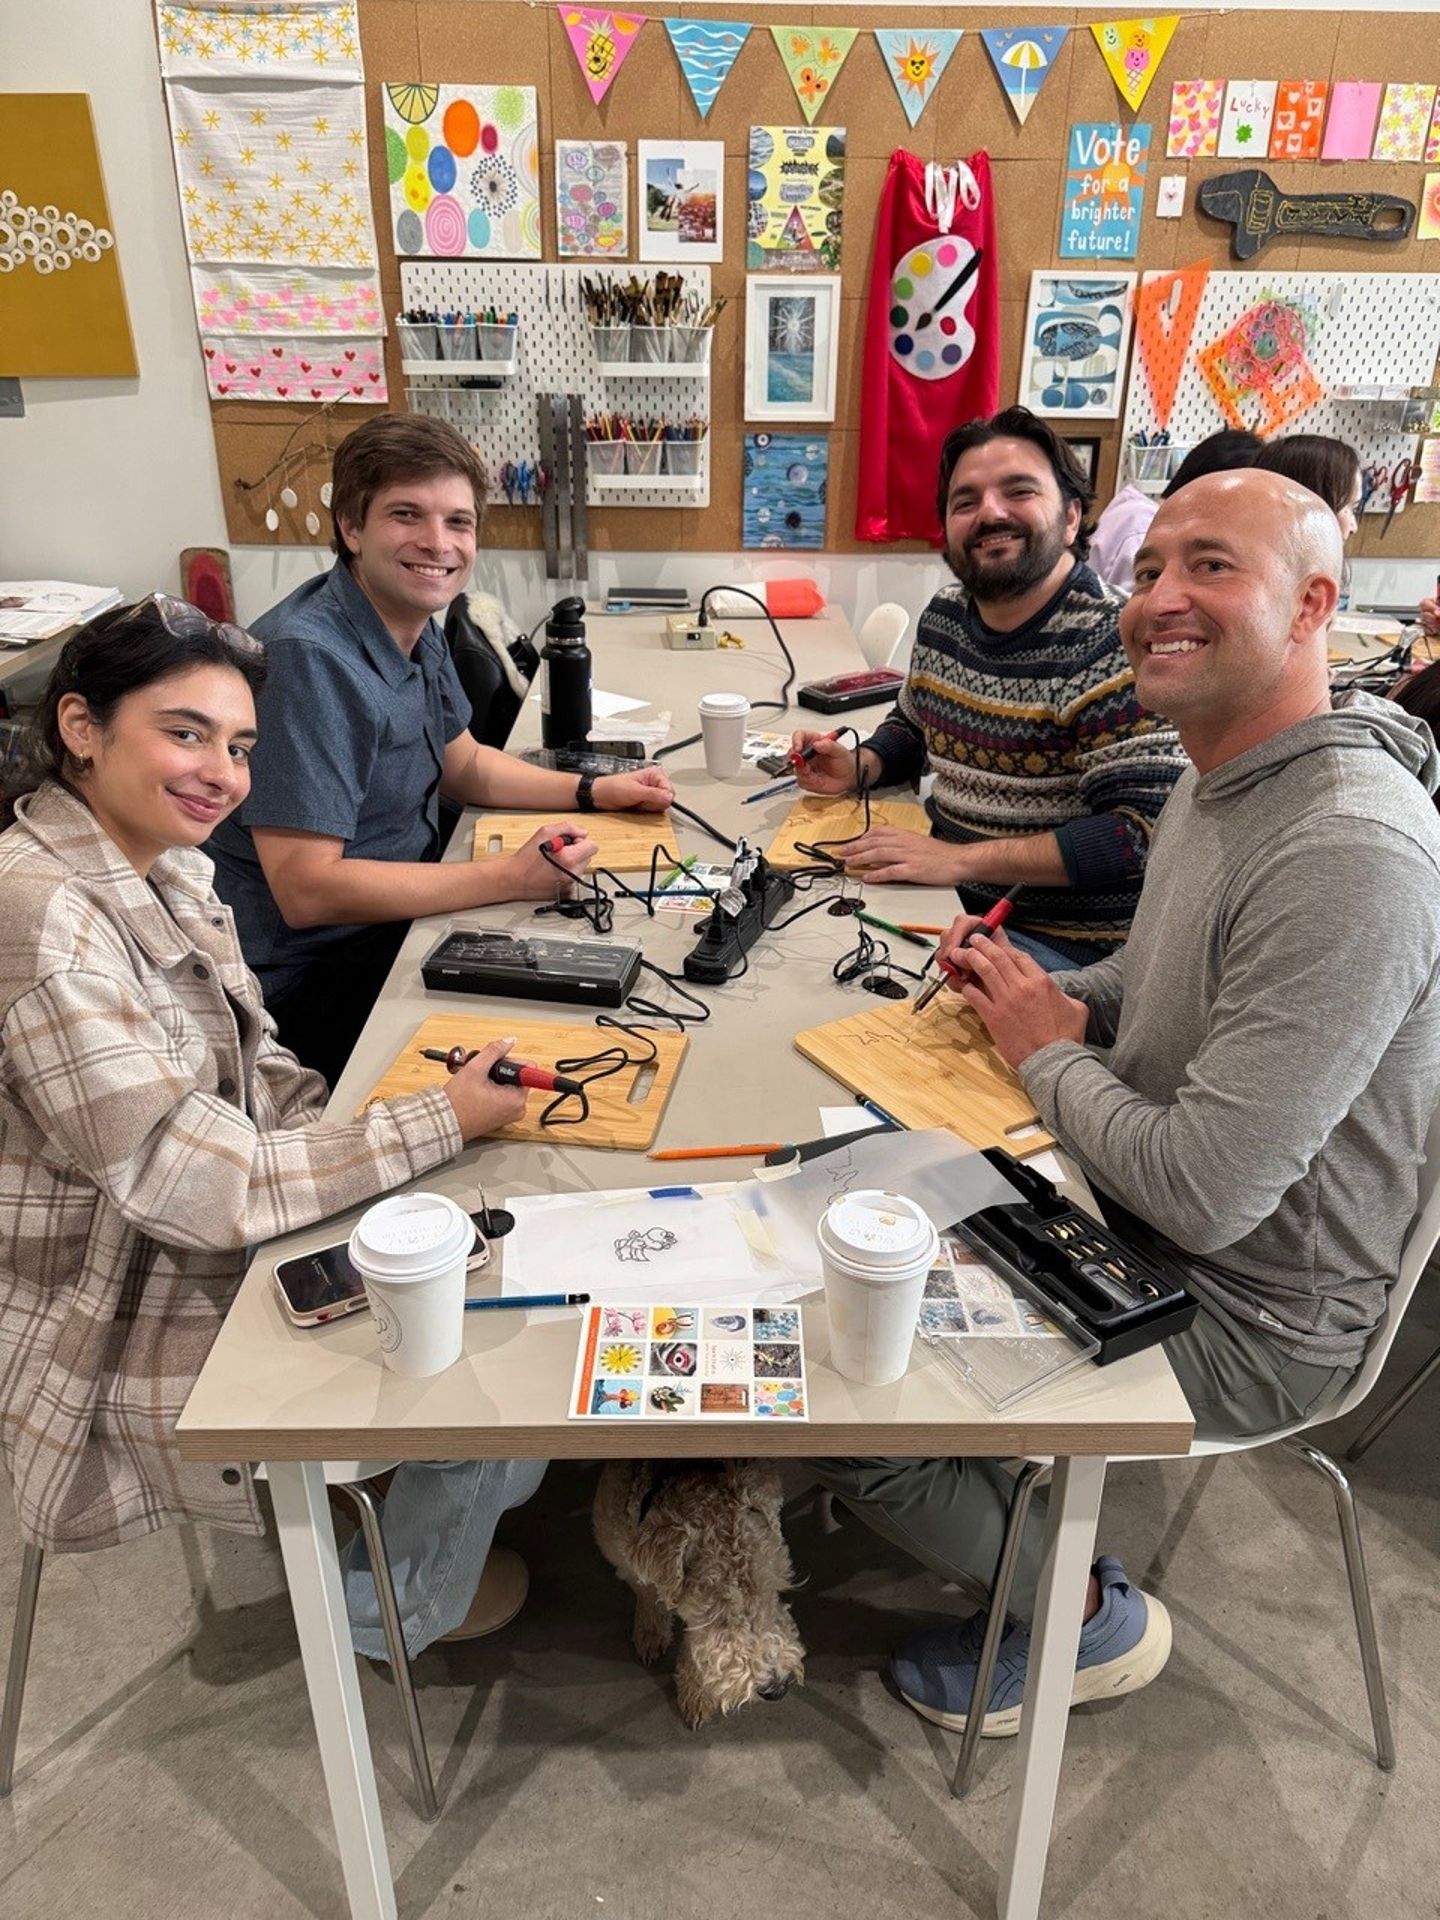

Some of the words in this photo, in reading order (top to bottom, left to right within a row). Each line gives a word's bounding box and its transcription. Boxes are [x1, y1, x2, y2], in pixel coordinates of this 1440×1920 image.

[1075, 128, 1140, 166] Vote
[1080, 172, 1111, 195] for
[1118, 177, 1130, 193] a
[1071, 200, 1136, 226] brighter
[1067, 229, 1131, 252] future!
